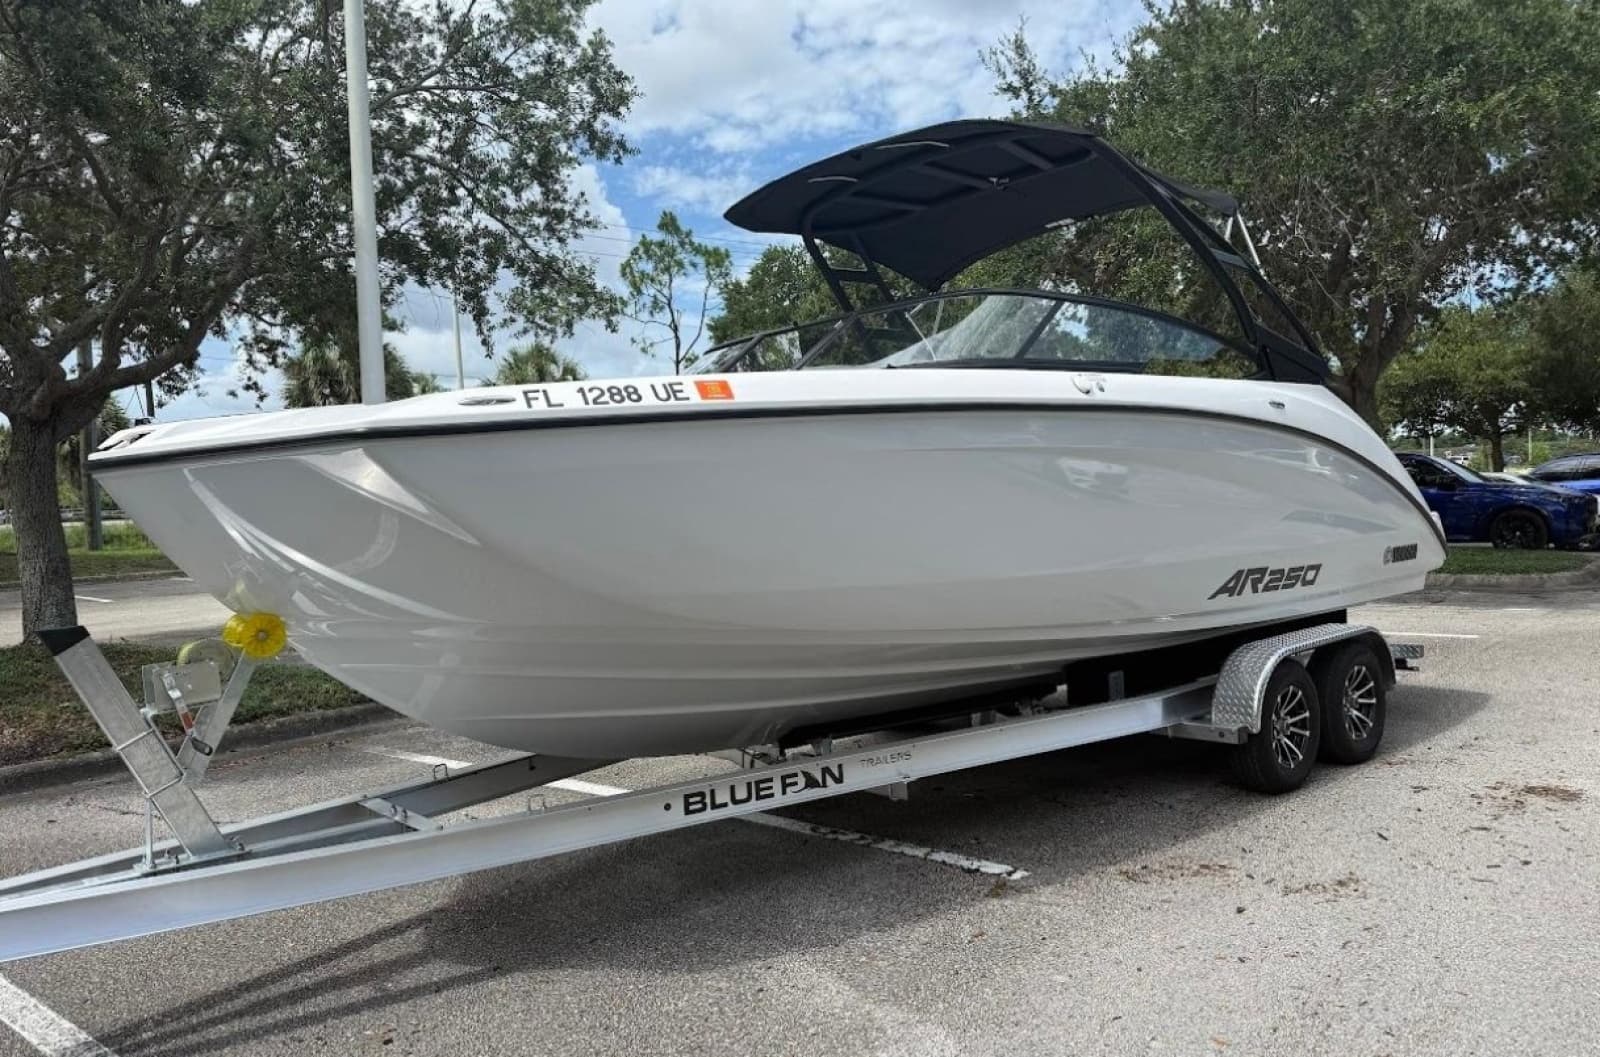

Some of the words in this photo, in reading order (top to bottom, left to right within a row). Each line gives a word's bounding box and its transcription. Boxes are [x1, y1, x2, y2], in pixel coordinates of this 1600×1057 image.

[522, 389, 564, 409] FL
[576, 385, 642, 406] 1288
[650, 382, 690, 402] UE
[1207, 563, 1323, 600] AR250
[860, 751, 912, 768] TRAILERS
